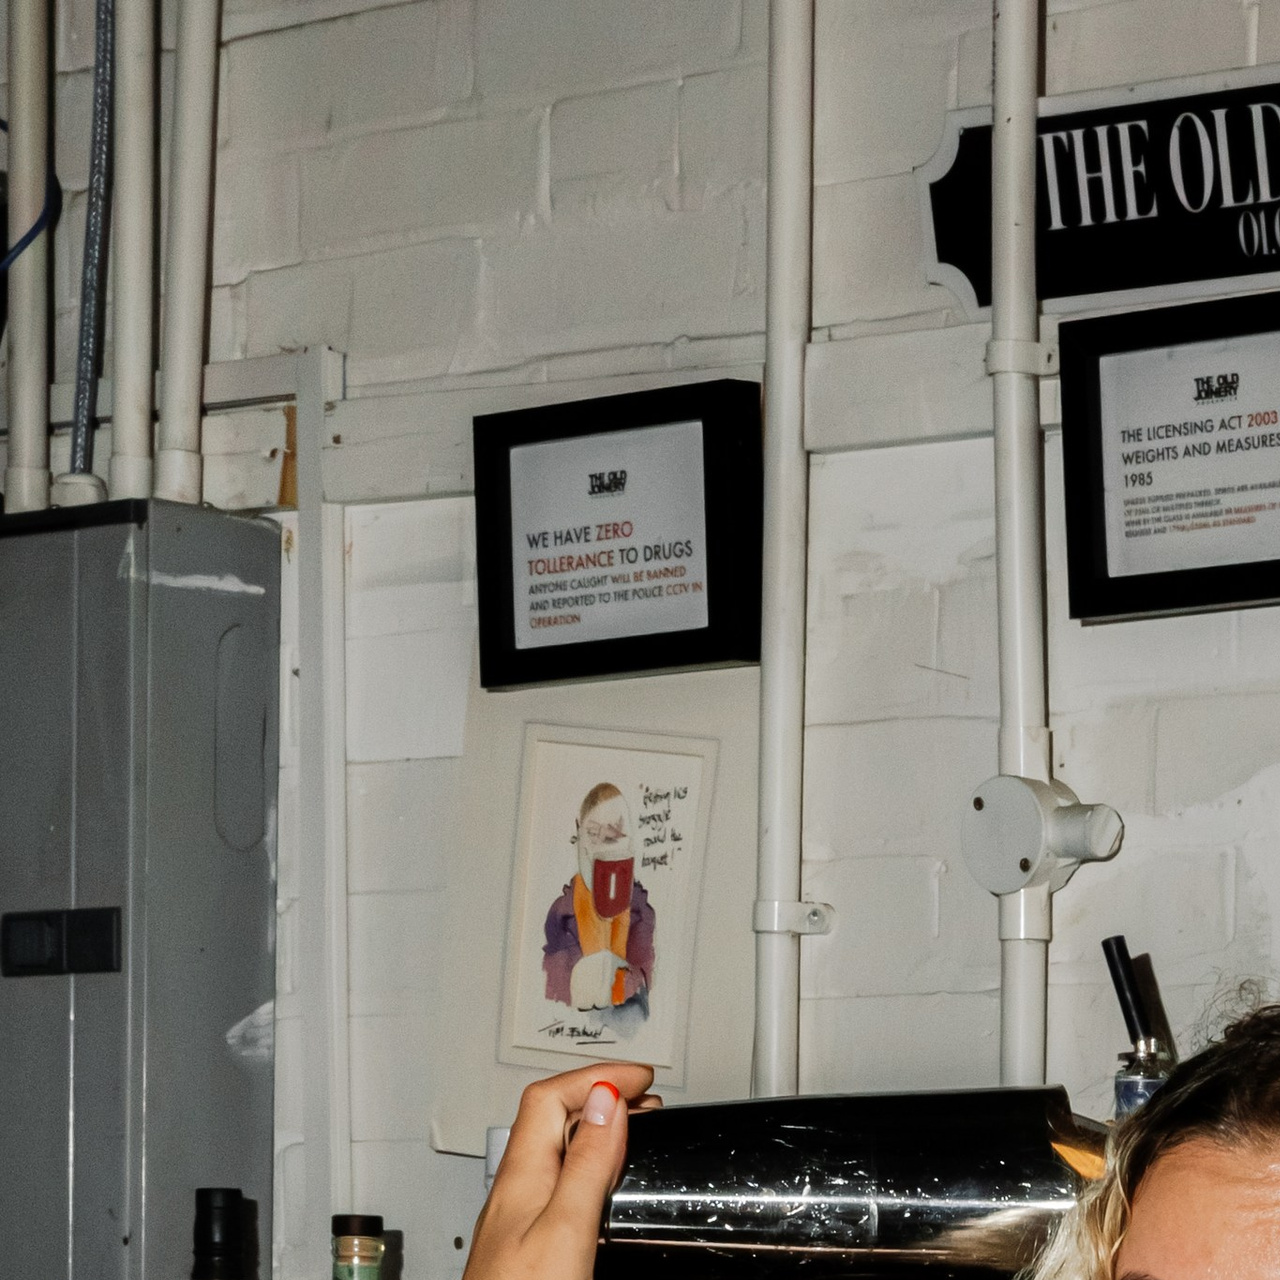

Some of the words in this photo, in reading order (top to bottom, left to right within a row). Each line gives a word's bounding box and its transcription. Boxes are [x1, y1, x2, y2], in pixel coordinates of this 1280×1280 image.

[1039, 119, 1158, 231] THE
[1193, 386, 1238, 402] JOINERY
[1194, 376, 1214, 390] THE
[1217, 373, 1240, 387] OLD
[1121, 427, 1143, 444] THE
[1147, 419, 1214, 441] LICENSING
[1218, 415, 1243, 431] ACT
[1247, 410, 1279, 428] 2003
[1122, 446, 1178, 465] WEIGHTS
[1183, 442, 1211, 459] AND
[1124, 472, 1153, 488] 1985
[526, 532, 549, 549] WE
[553, 526, 591, 547] HAVE
[596, 521, 633, 541] ZERO
[528, 550, 614, 576] TOLLERANCE
[618, 547, 638, 564] TO
[643, 540, 693, 562] DRUGS
[528, 581, 568, 596] ANYONE
[570, 575, 608, 590] CAUGHT
[611, 571, 630, 584] WILL
[633, 570, 643, 581] BE
[646, 566, 686, 580] BANNED
[529, 599, 549, 611] AND
[551, 593, 596, 609] REPORTED
[599, 592, 611, 603] TO
[614, 589, 629, 601] THE
[632, 584, 663, 599] POLICE
